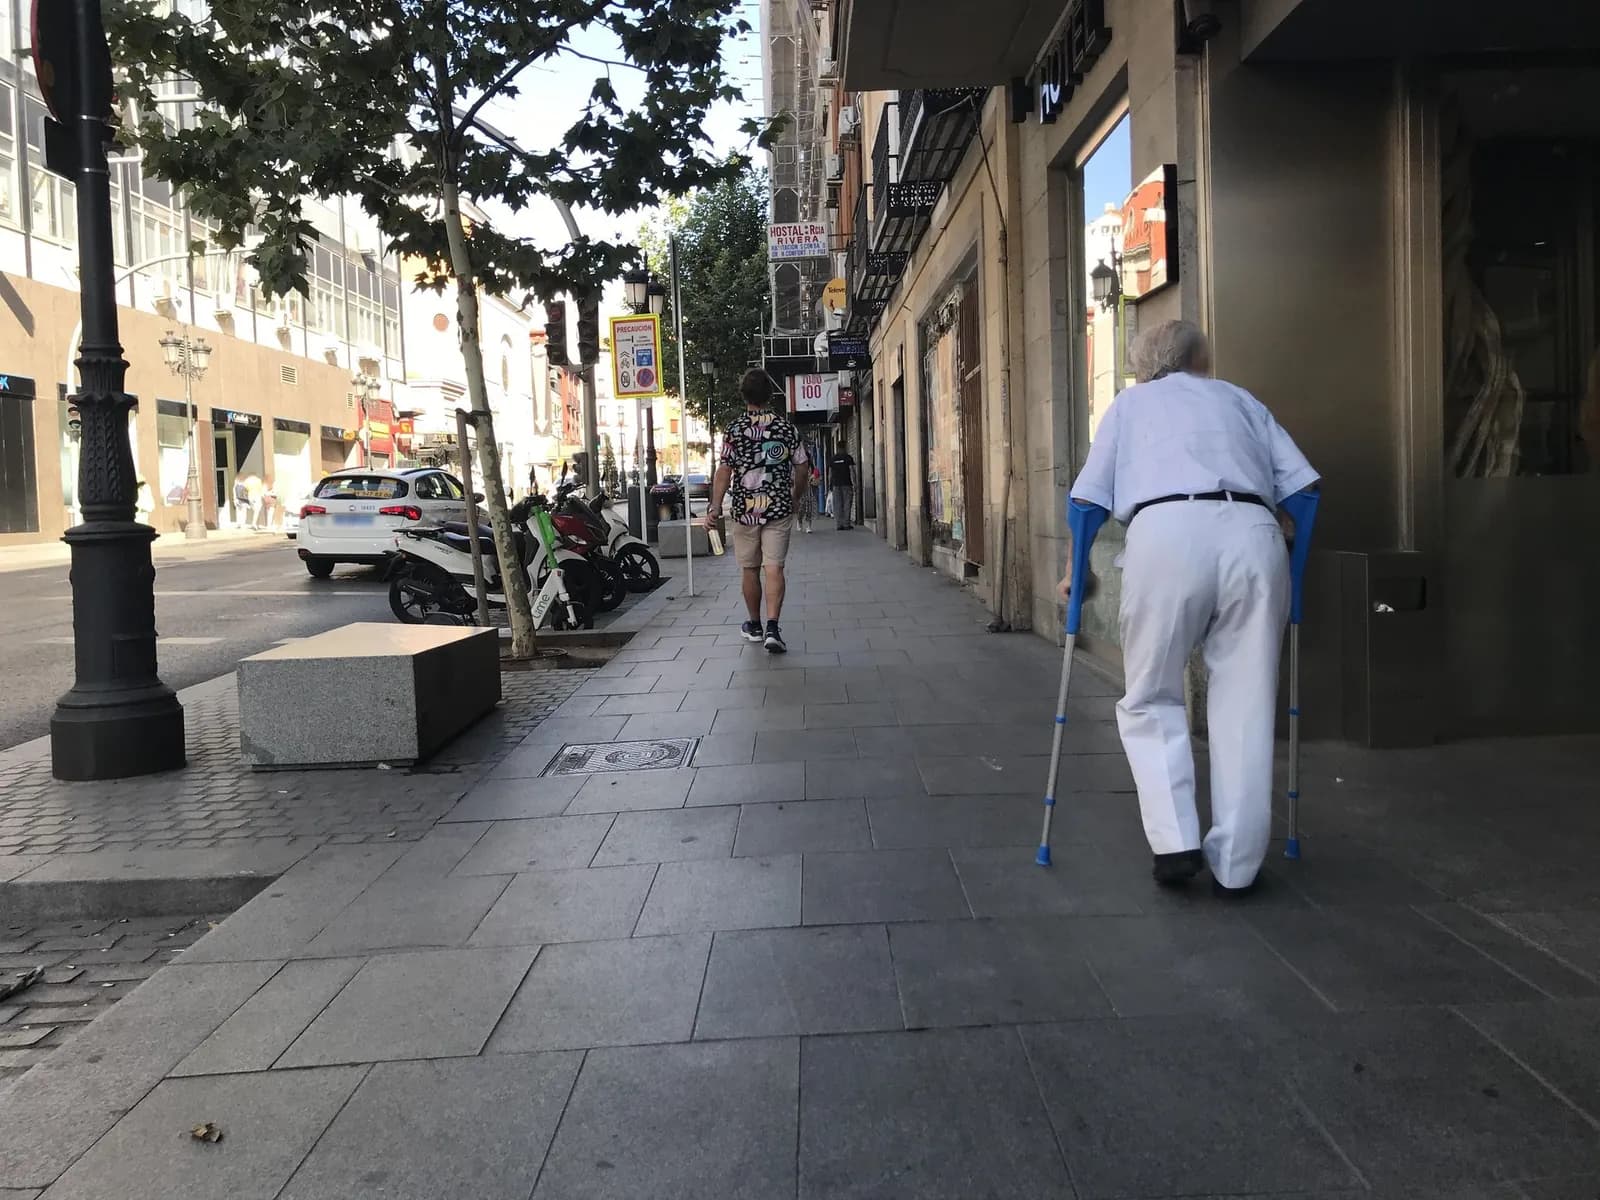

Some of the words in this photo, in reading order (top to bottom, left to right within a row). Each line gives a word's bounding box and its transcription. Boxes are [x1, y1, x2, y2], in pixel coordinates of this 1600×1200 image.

[770, 225, 804, 237] HOSTAL
[777, 235, 819, 245] RIVERA
[802, 384, 822, 399] 100
